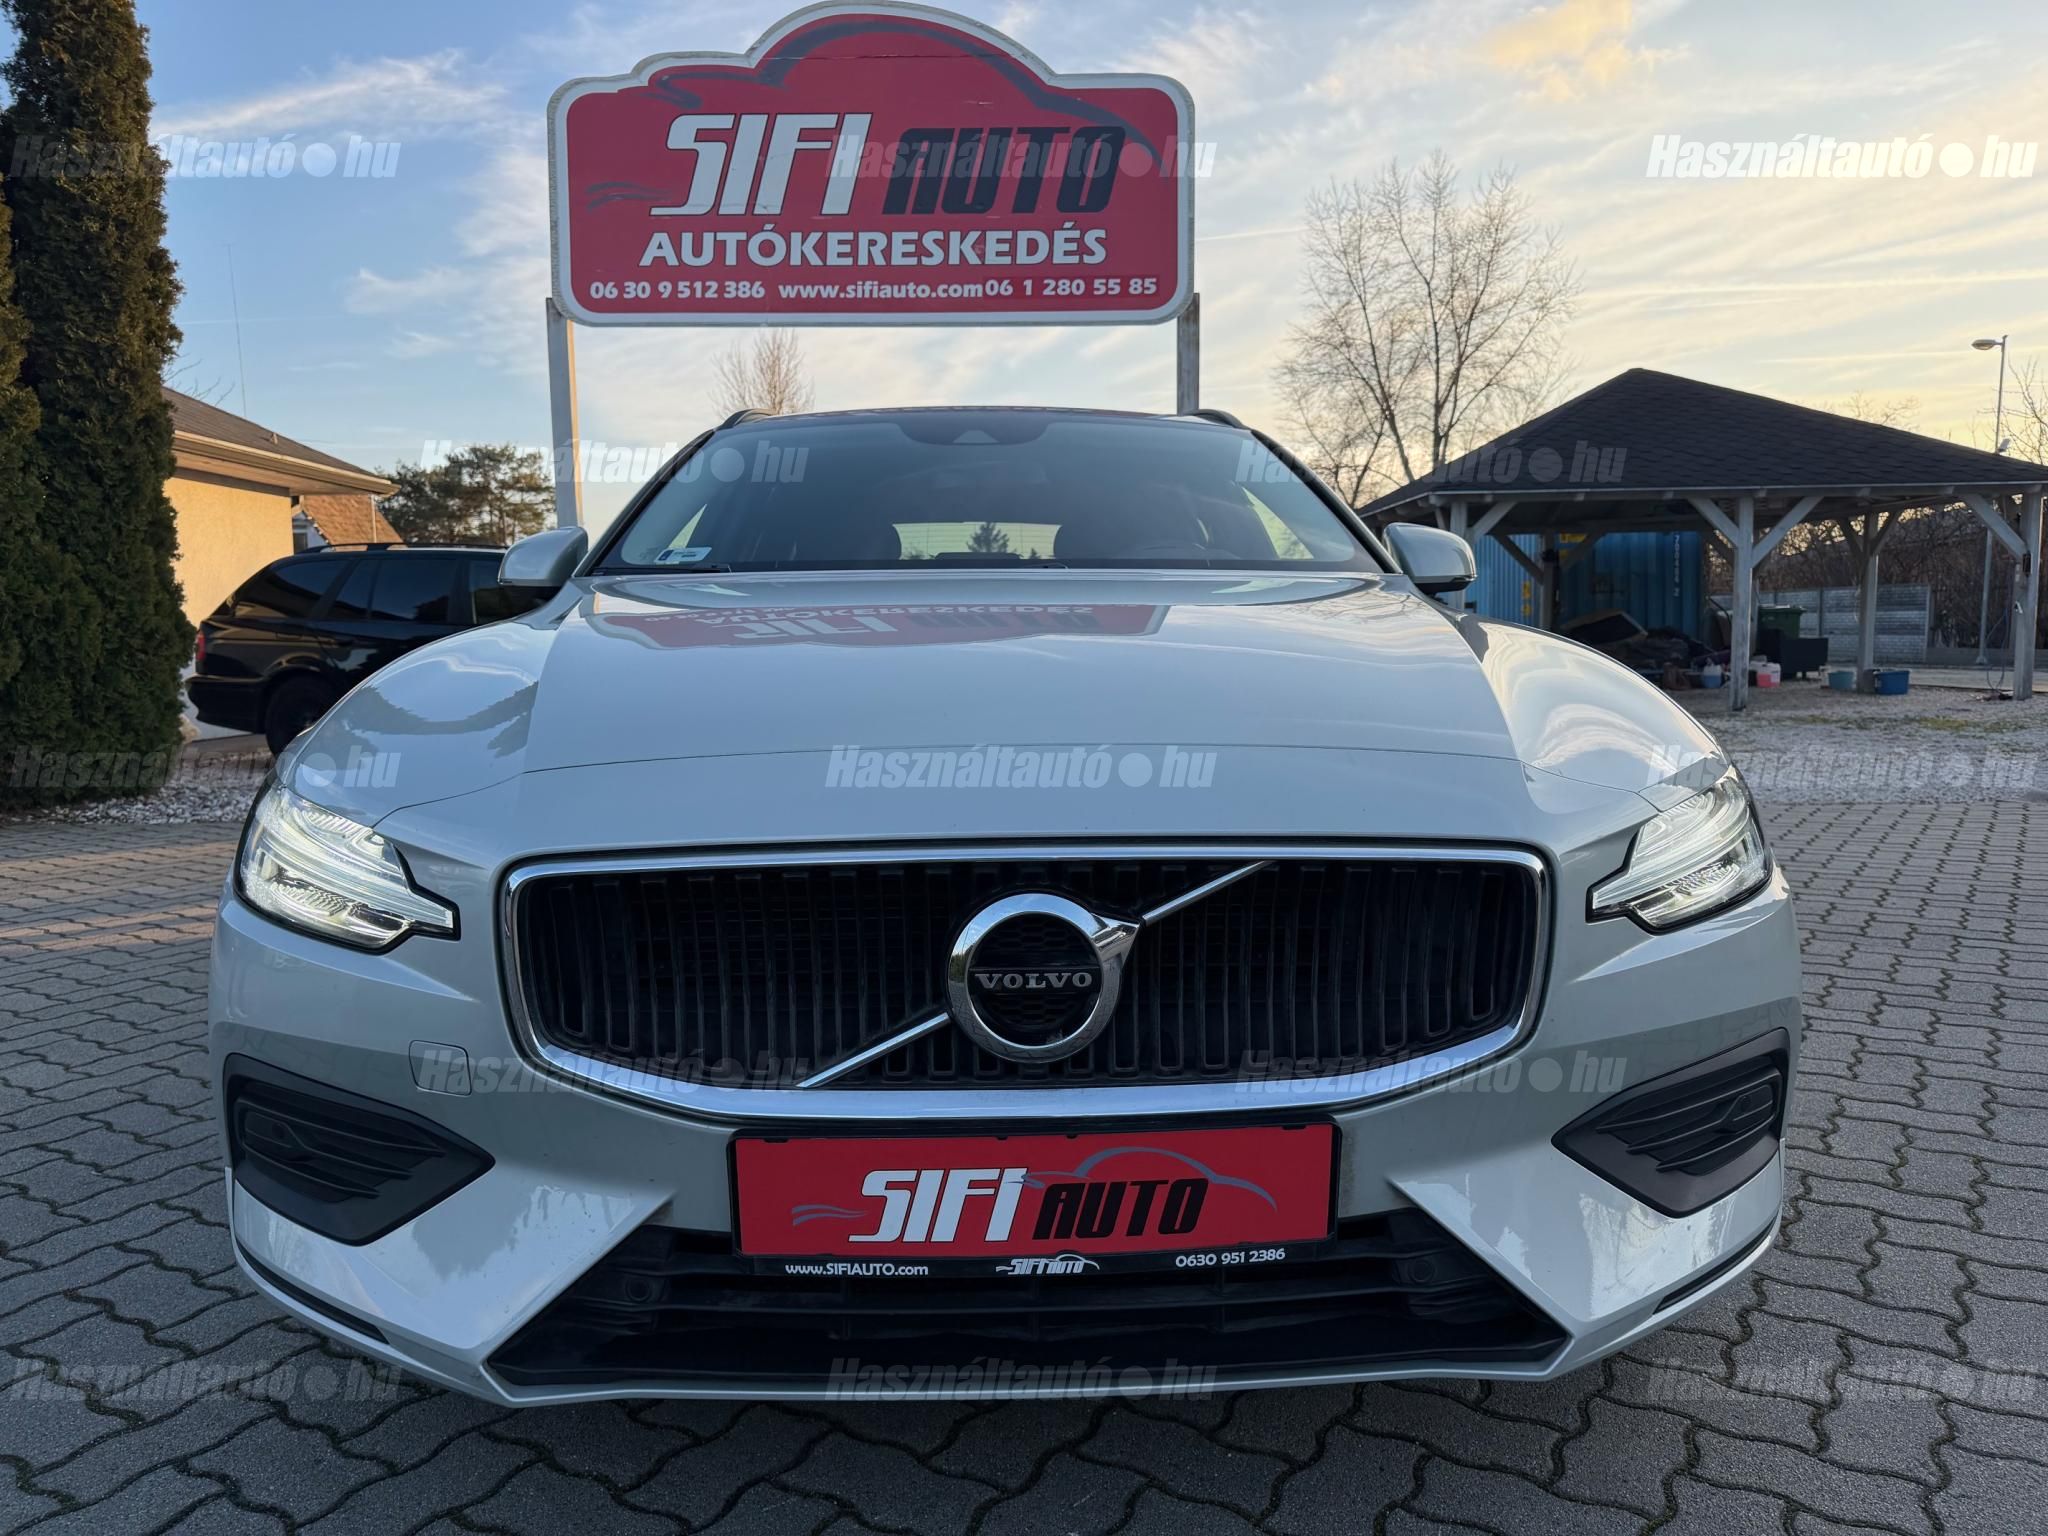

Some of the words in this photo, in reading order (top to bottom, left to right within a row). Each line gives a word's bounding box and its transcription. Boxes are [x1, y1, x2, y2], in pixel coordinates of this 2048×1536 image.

[649, 113, 872, 215] SIFI
[883, 125, 1126, 214] AUTO
[638, 220, 1107, 267] AUTÓKERESKEDÉS
[590, 281, 618, 298] 06
[623, 281, 651, 298] 30
[723, 280, 766, 298] 386
[778, 280, 983, 299] www.sifiauto.com
[985, 278, 1013, 296] 06
[1023, 278, 1033, 296] 1
[1042, 278, 1086, 296] 280
[1093, 278, 1121, 295] 55
[1128, 277, 1157, 295] 85
[974, 972, 1093, 989] VOLVO
[848, 1167, 1028, 1243] SIFI
[1032, 1177, 1209, 1240] AUTO
[1175, 1253, 1217, 1268] 0630
[1221, 1251, 1245, 1265] 951
[1249, 1248, 1286, 1263] 2386
[785, 1263, 929, 1276] www.SIFIAUTO.com
